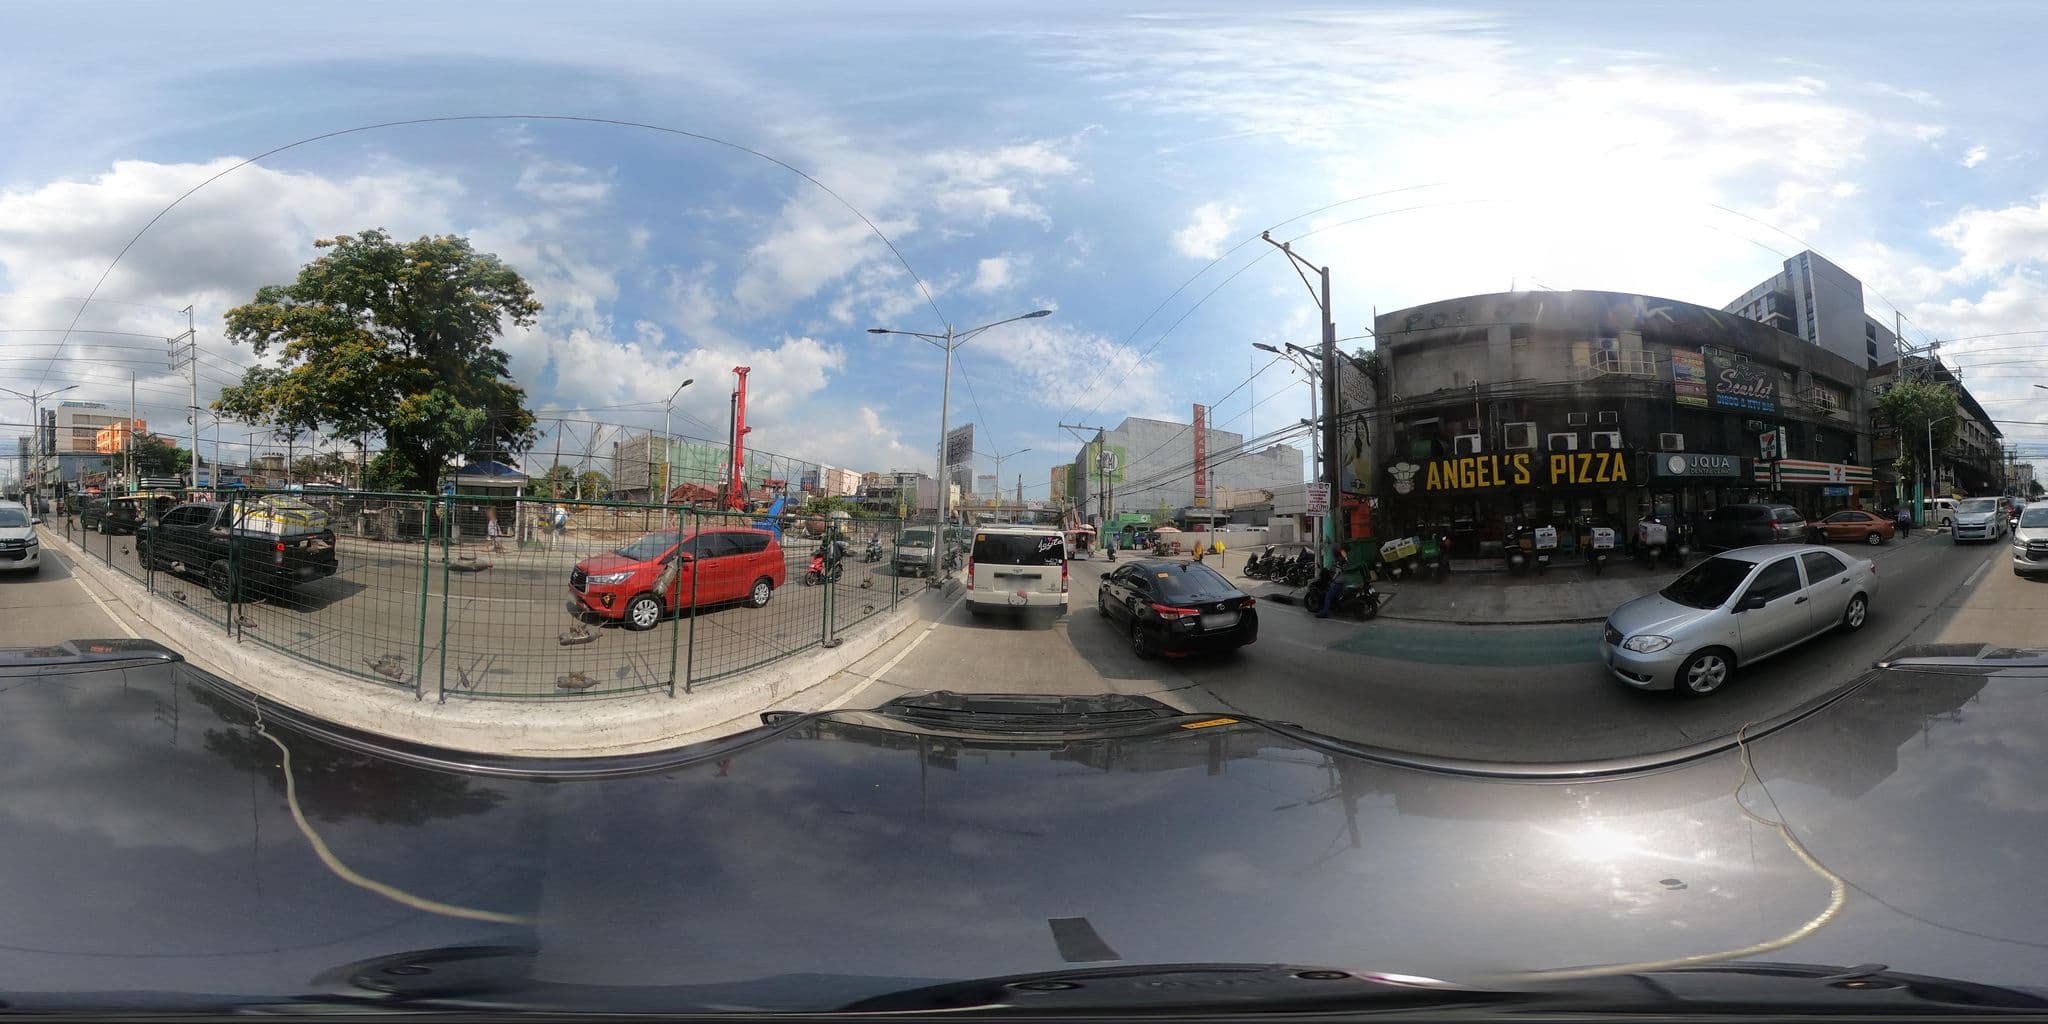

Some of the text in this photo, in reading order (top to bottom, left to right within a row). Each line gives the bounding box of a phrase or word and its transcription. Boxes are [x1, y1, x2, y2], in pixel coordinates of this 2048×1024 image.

[1716, 368, 1773, 399] Scarlet
[1716, 394, 1738, 407] DISCO
[1426, 452, 1628, 491] ANGEL'S PIZZA
[1691, 456, 1730, 468] JQUA
